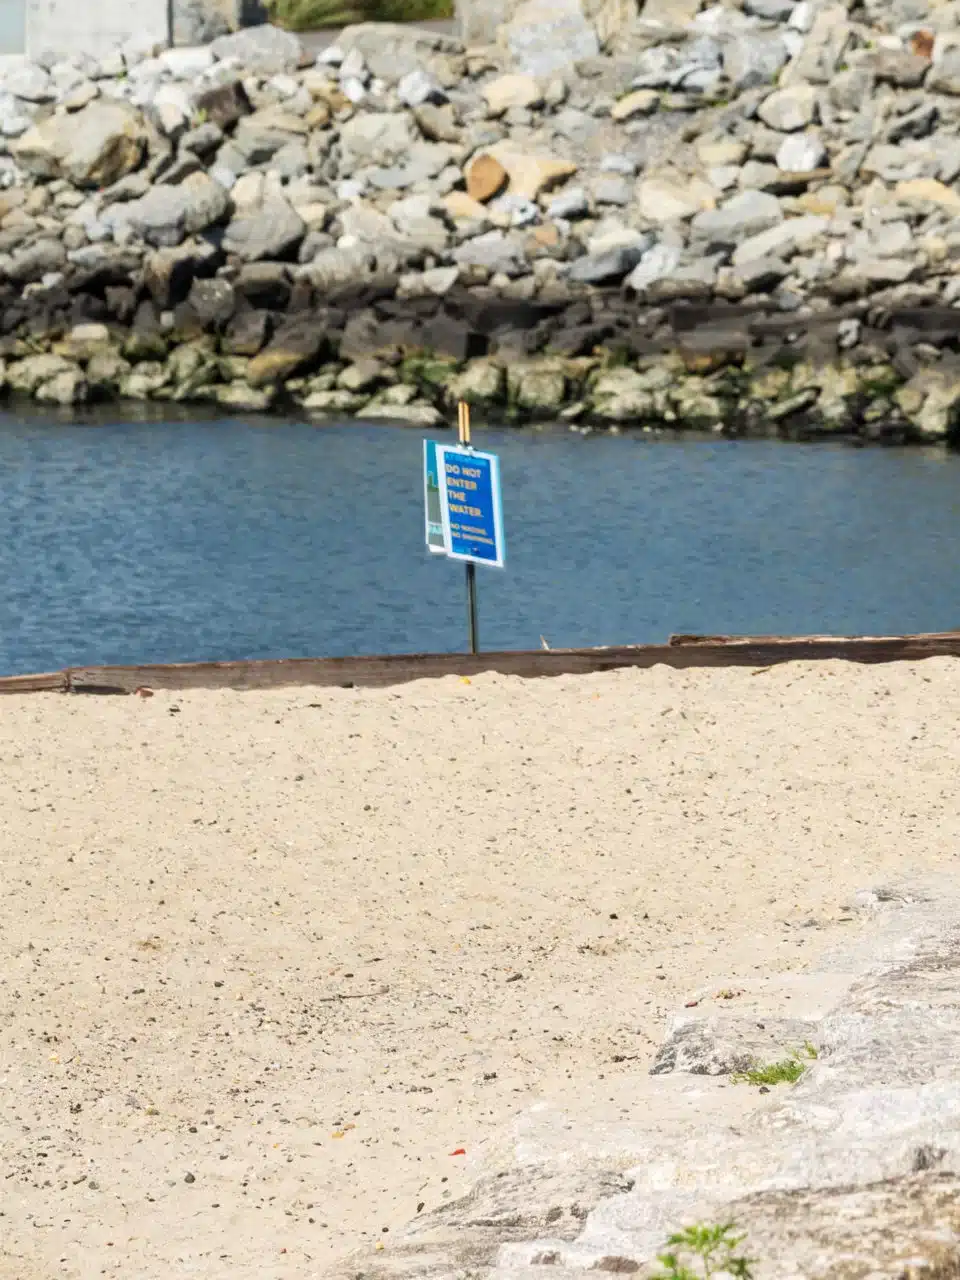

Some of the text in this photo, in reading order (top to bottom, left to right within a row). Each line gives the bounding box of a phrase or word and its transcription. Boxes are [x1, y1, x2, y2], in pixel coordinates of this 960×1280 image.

[445, 464, 481, 478] DO NOT
[447, 477, 477, 490] ENTER
[448, 490, 466, 501] THE
[449, 504, 484, 517] WATER.
